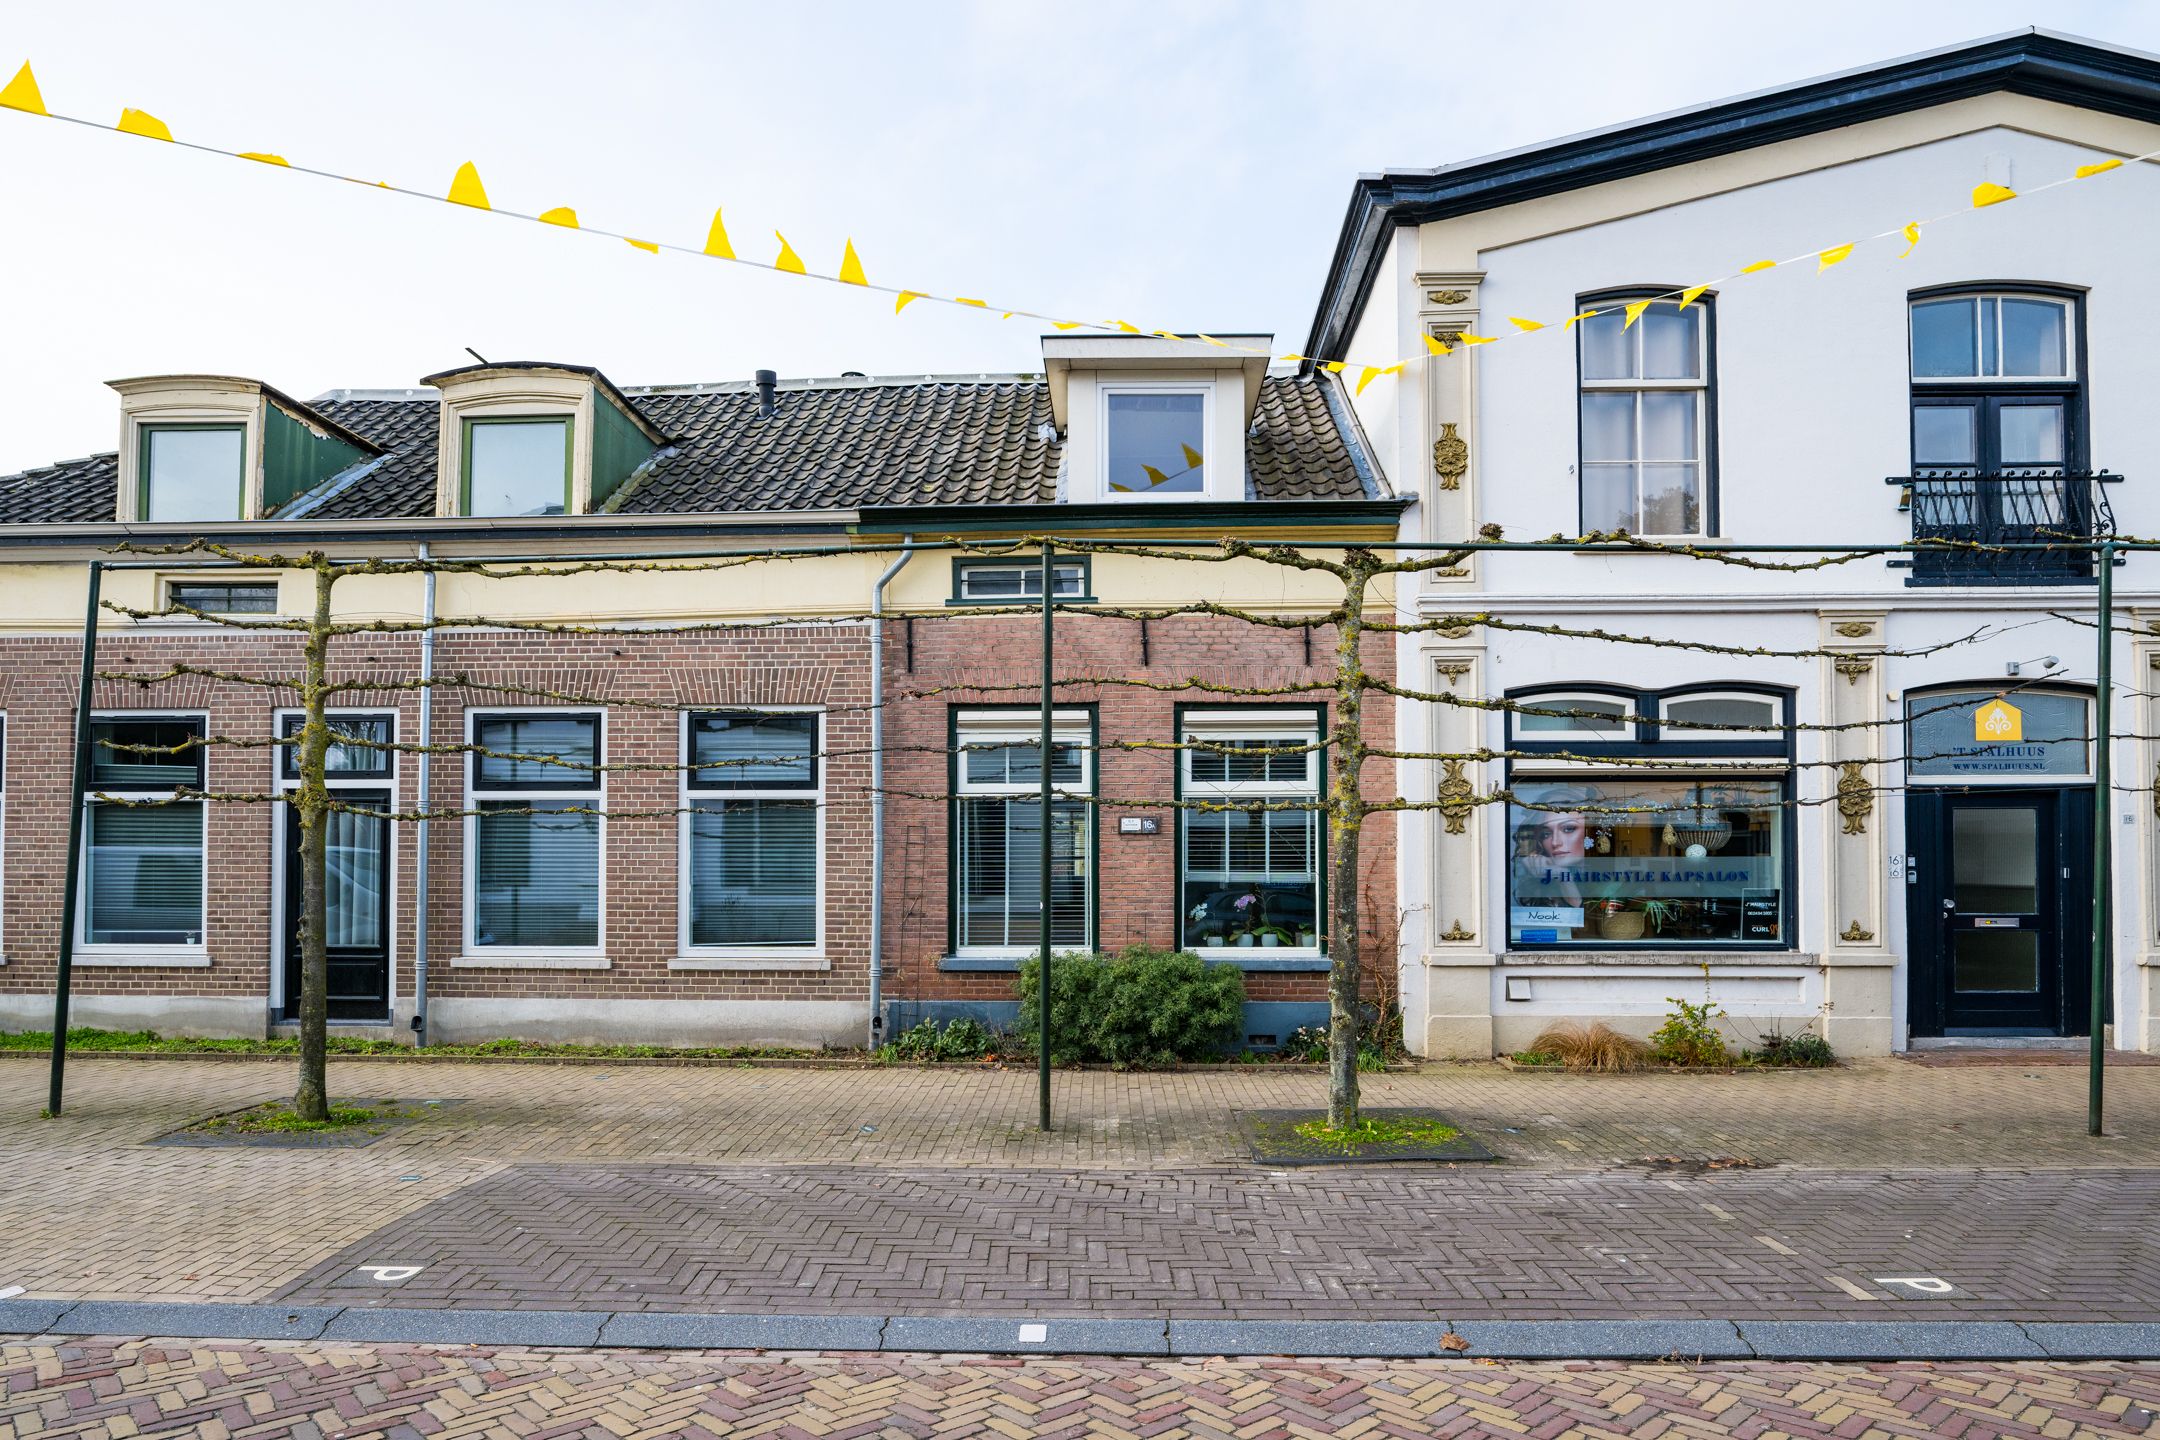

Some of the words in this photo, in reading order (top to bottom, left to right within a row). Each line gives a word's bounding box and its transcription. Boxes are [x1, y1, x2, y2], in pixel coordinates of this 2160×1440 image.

[1970, 746, 2046, 757] SPALHUUS
[1540, 868, 1655, 885] J-HAIRSTYLE
[1661, 871, 1750, 882] KAPSALON
[1528, 910, 1561, 921] Nook
